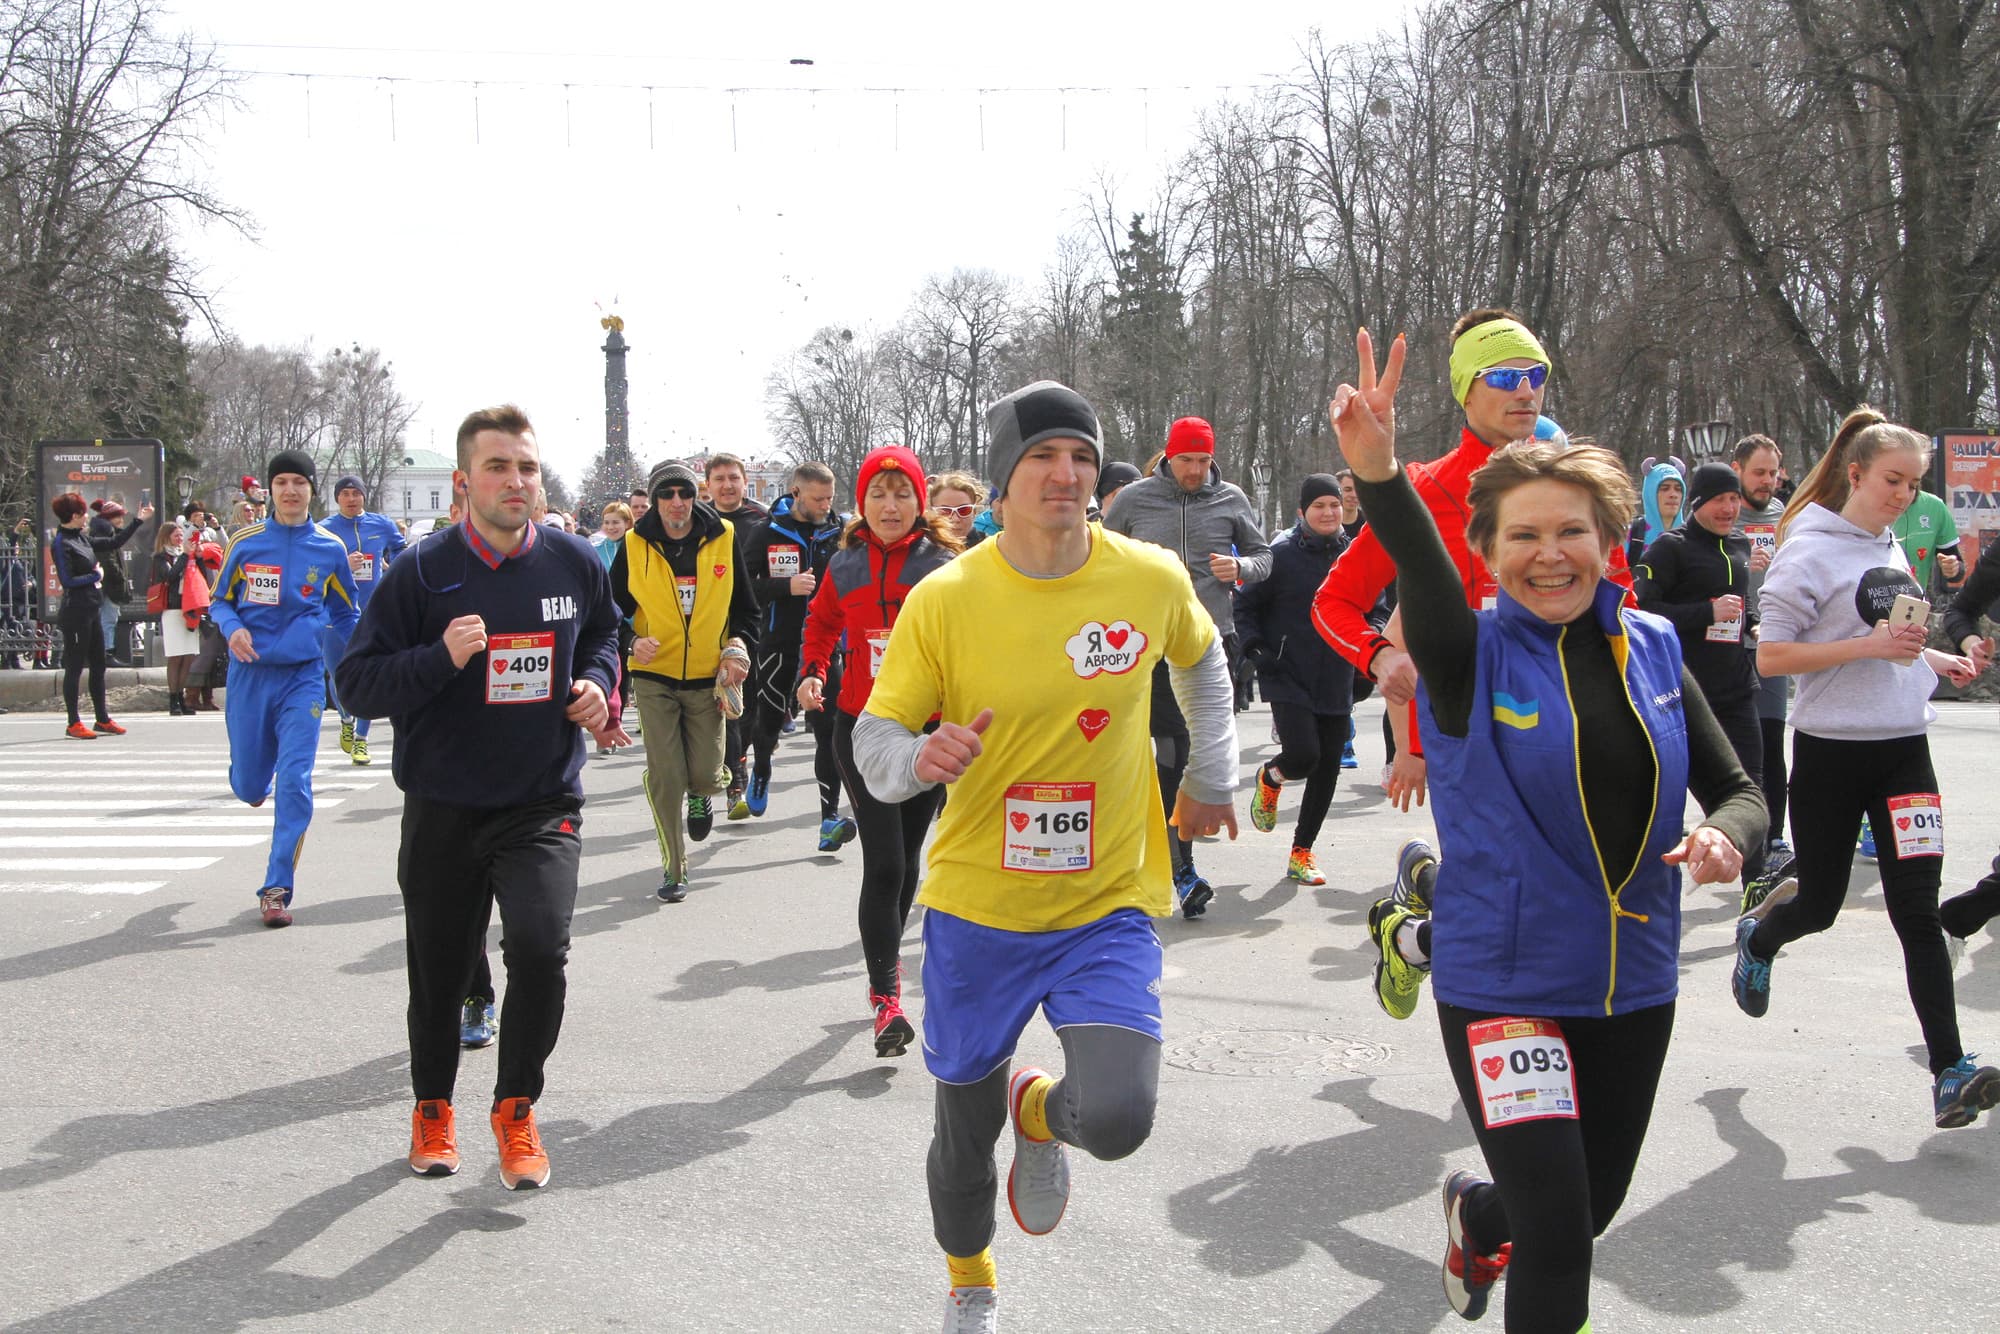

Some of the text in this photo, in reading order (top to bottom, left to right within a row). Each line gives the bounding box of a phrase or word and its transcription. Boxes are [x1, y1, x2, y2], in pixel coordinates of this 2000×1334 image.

[1952, 440, 2000, 457] ЧАШК
[67, 471, 107, 483] Gym
[1756, 537, 1775, 546] 094
[777, 555, 799, 565] 029
[255, 577, 279, 589] 036
[1087, 631, 1102, 653] Я
[510, 655, 549, 673] 409
[1085, 652, 1130, 668] АВРОРУ
[1035, 811, 1089, 834] 166
[1914, 813, 1942, 830] 015
[1509, 1047, 1569, 1075] 093
